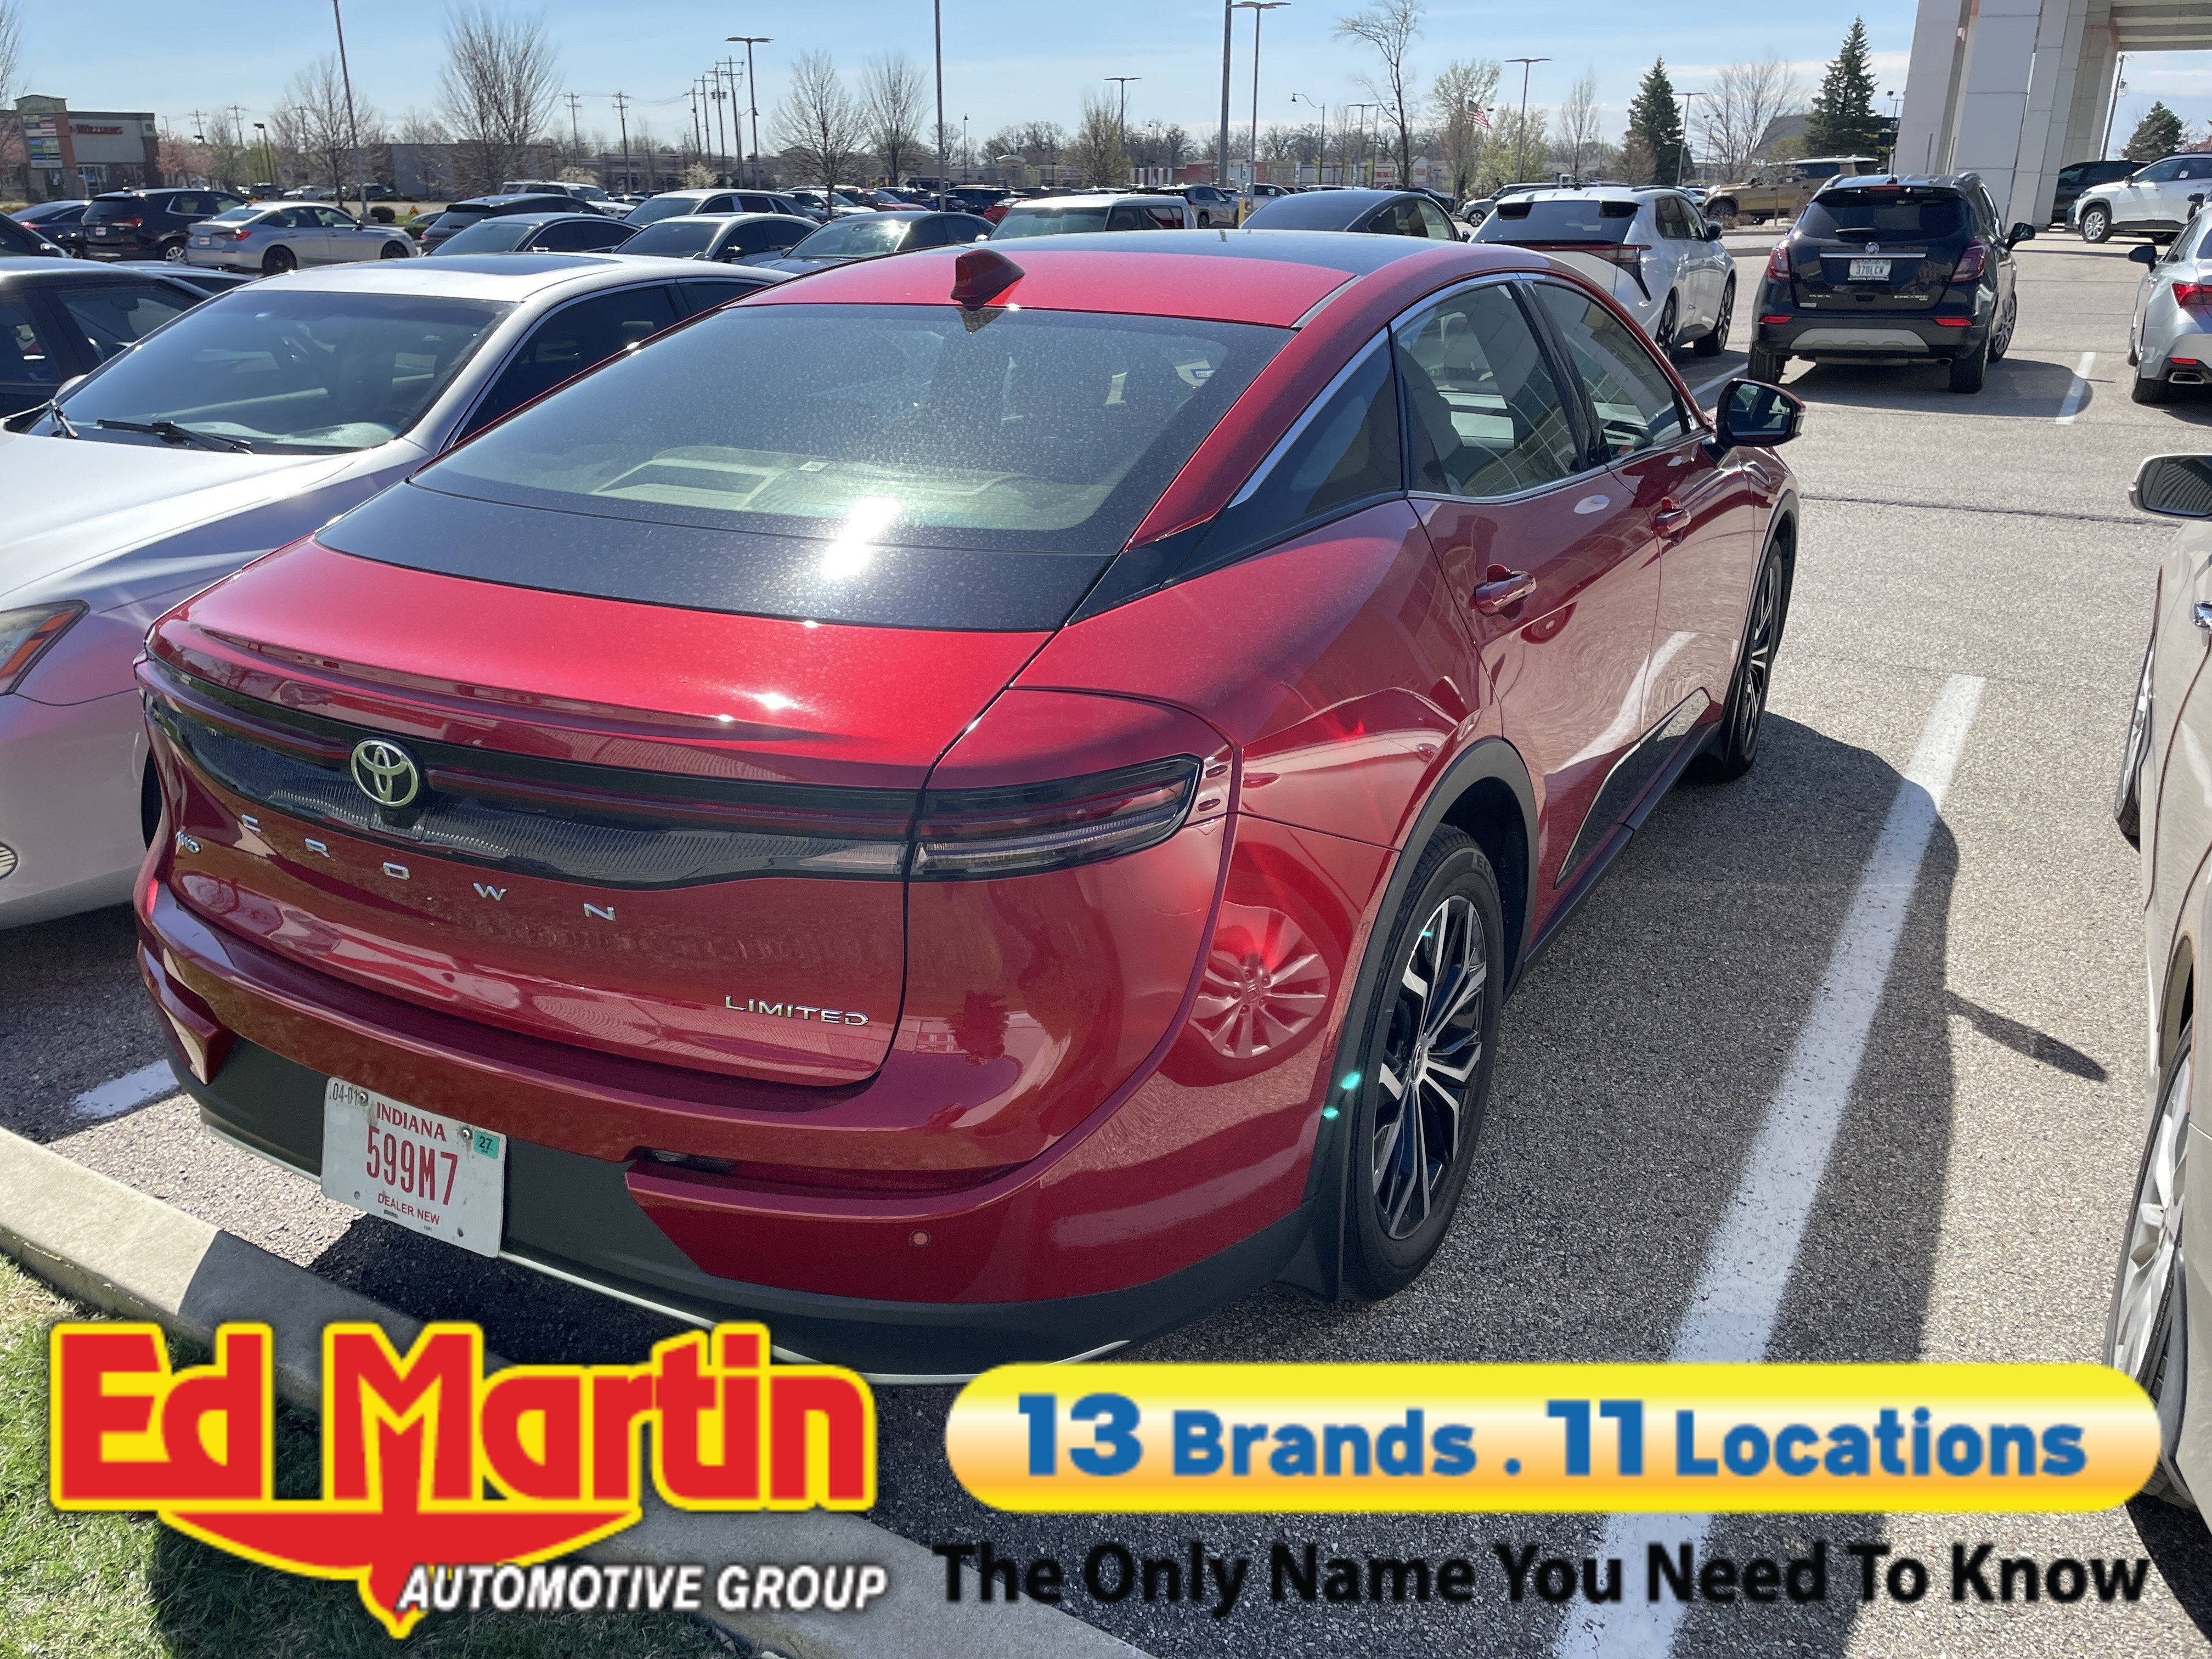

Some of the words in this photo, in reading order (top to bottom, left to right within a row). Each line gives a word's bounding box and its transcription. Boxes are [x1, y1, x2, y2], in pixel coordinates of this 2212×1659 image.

[240, 813, 616, 921] CROWN
[725, 995, 869, 1026] LIMITED
[376, 1101, 447, 1142] INDIANA
[478, 1136, 493, 1150] 27
[366, 1125, 458, 1206] 599M7
[377, 1193, 414, 1217] DEALER
[417, 1209, 440, 1225] NEW
